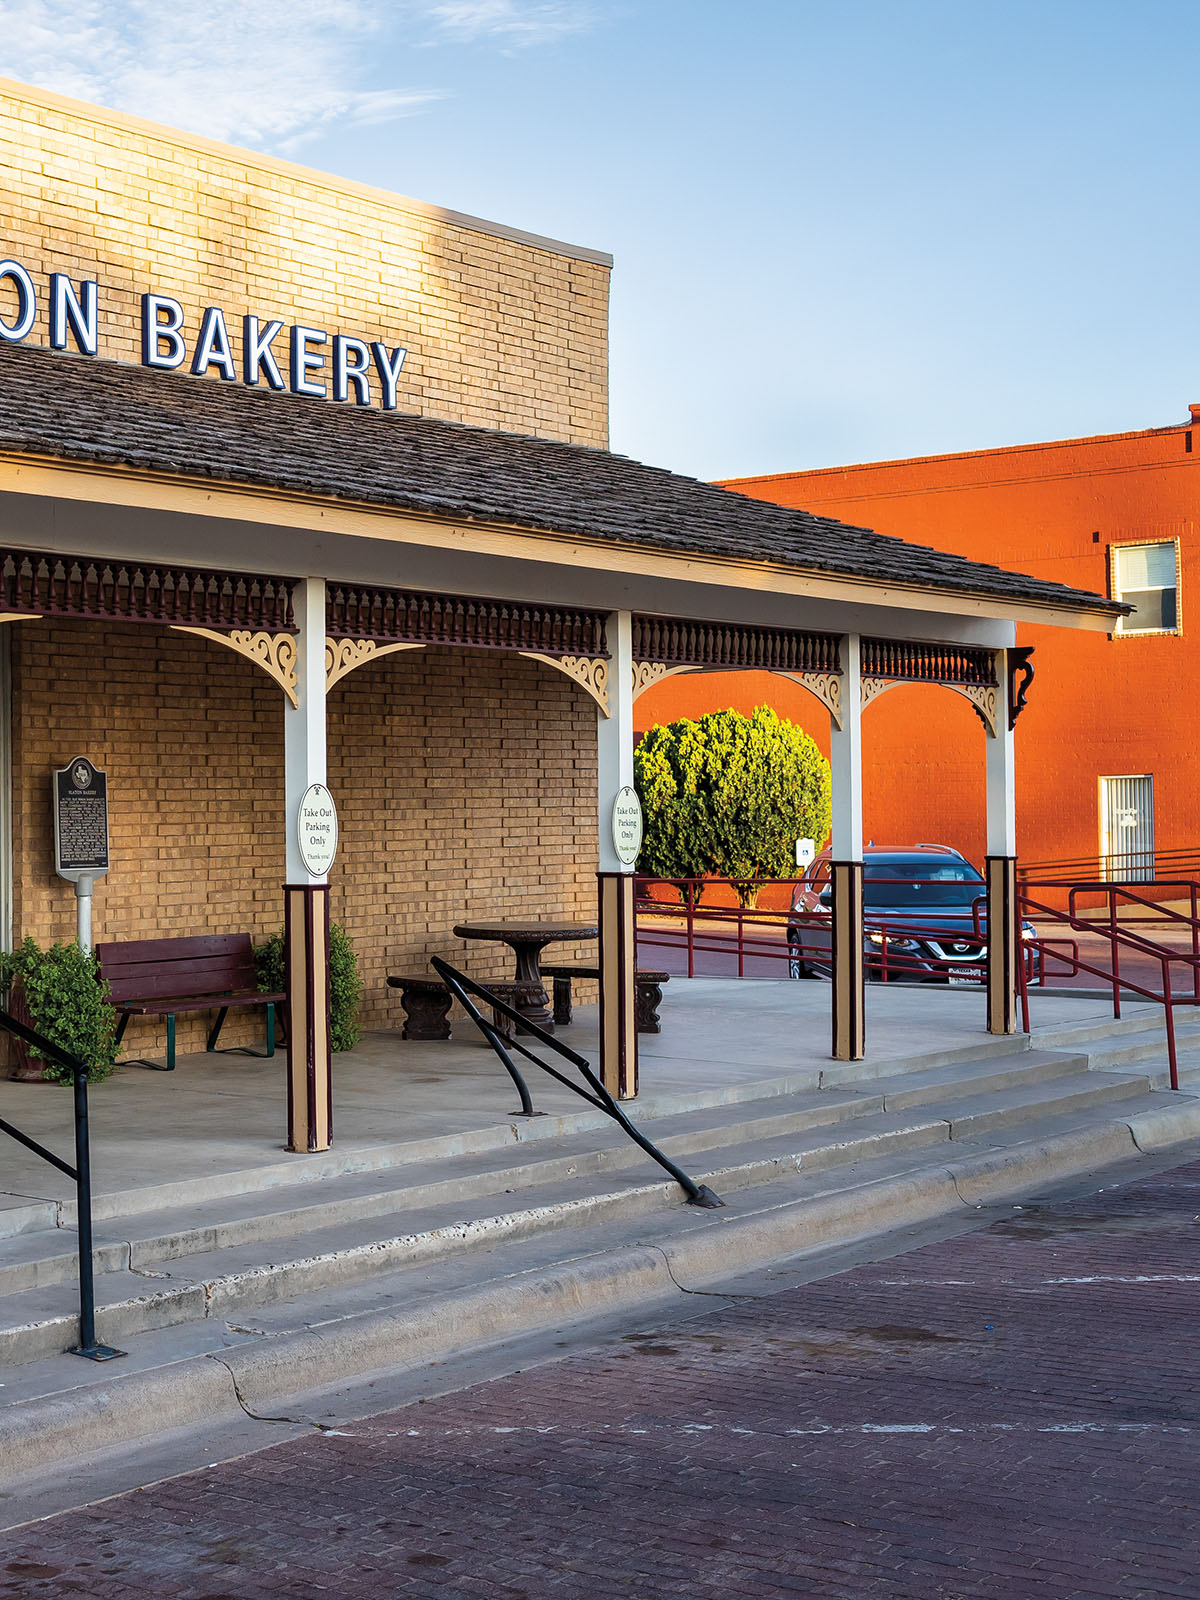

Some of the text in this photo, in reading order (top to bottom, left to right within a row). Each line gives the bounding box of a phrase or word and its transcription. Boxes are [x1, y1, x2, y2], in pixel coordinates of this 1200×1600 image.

[141, 293, 407, 410] BAKERY
[303, 808, 332, 817] Take Out
[617, 807, 638, 815] Take Out
[305, 822, 330, 833] Parking
[618, 819, 637, 829] Parking
[621, 831, 633, 840] Only
[310, 836, 326, 847] Only
